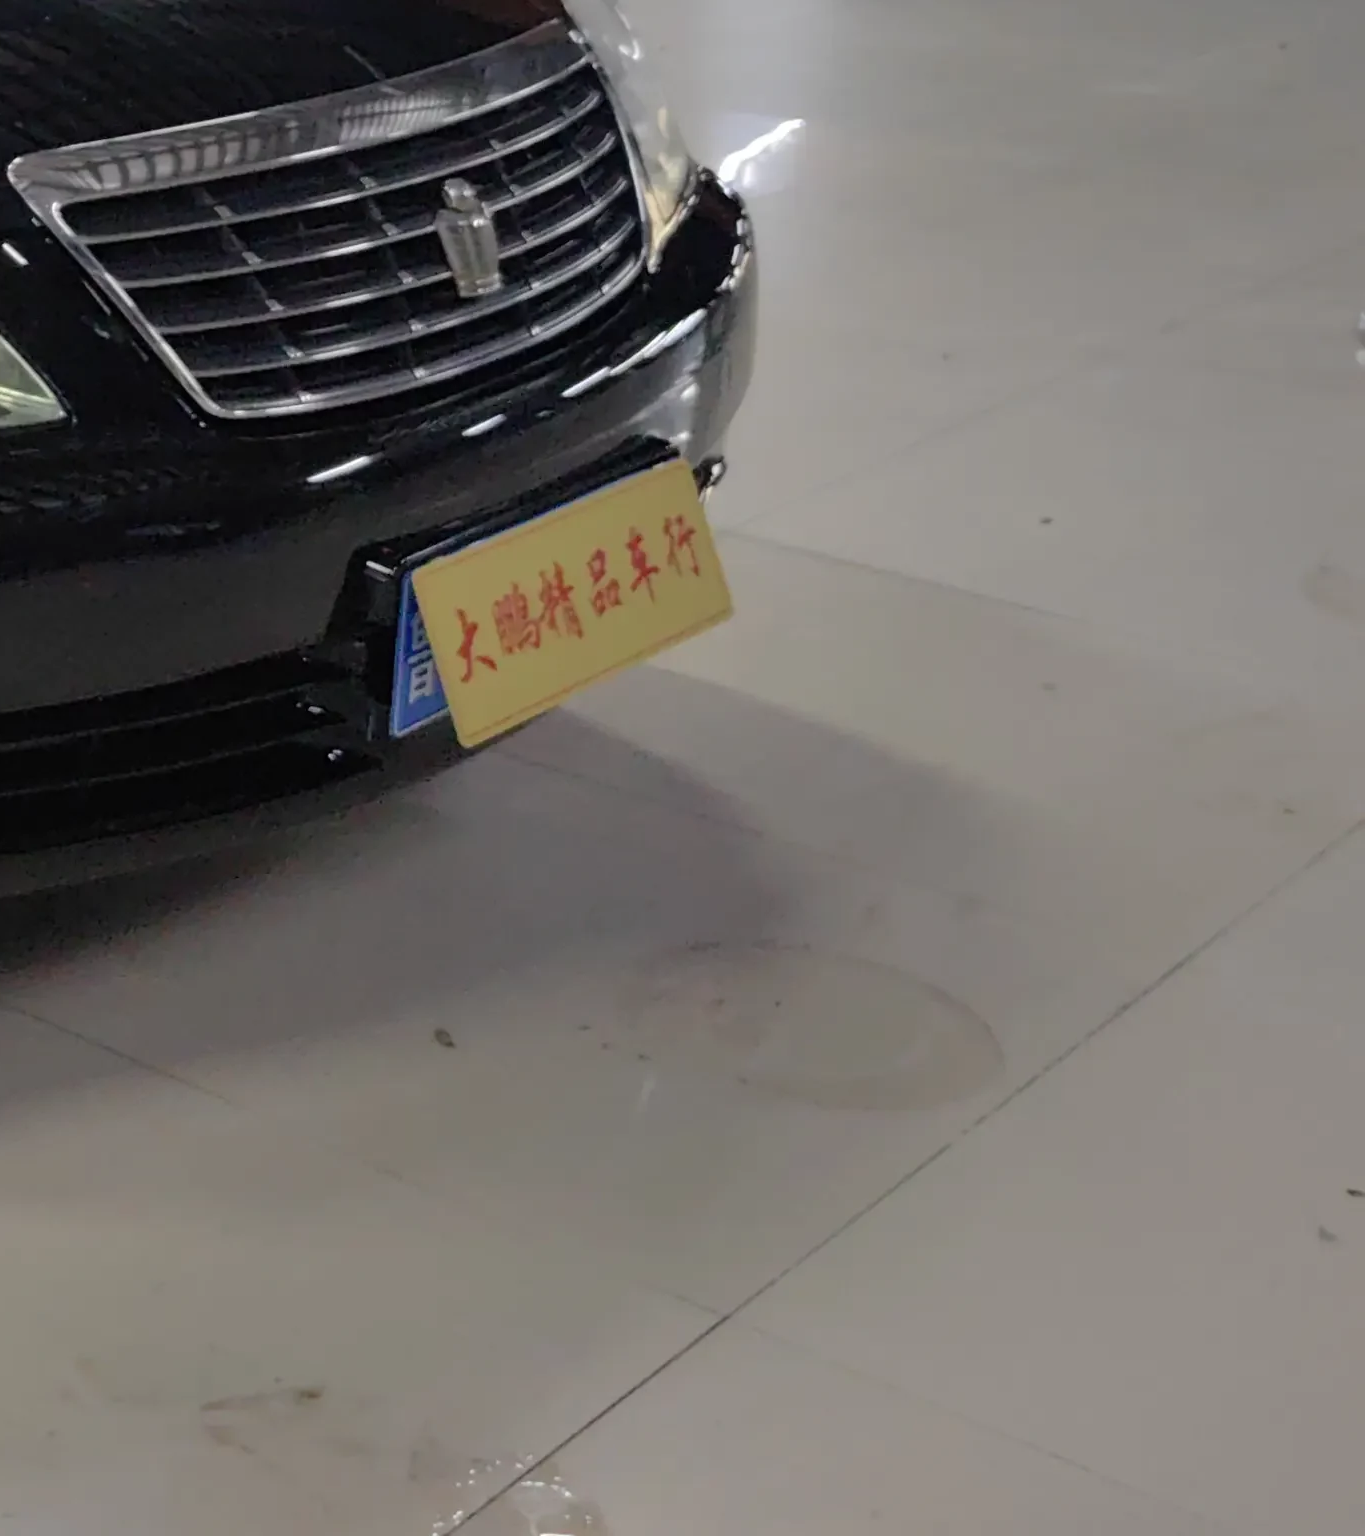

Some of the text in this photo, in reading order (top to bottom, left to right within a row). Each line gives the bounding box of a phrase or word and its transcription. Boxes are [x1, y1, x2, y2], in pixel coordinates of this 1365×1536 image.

[456, 514, 701, 684] 大鹏精品车行
